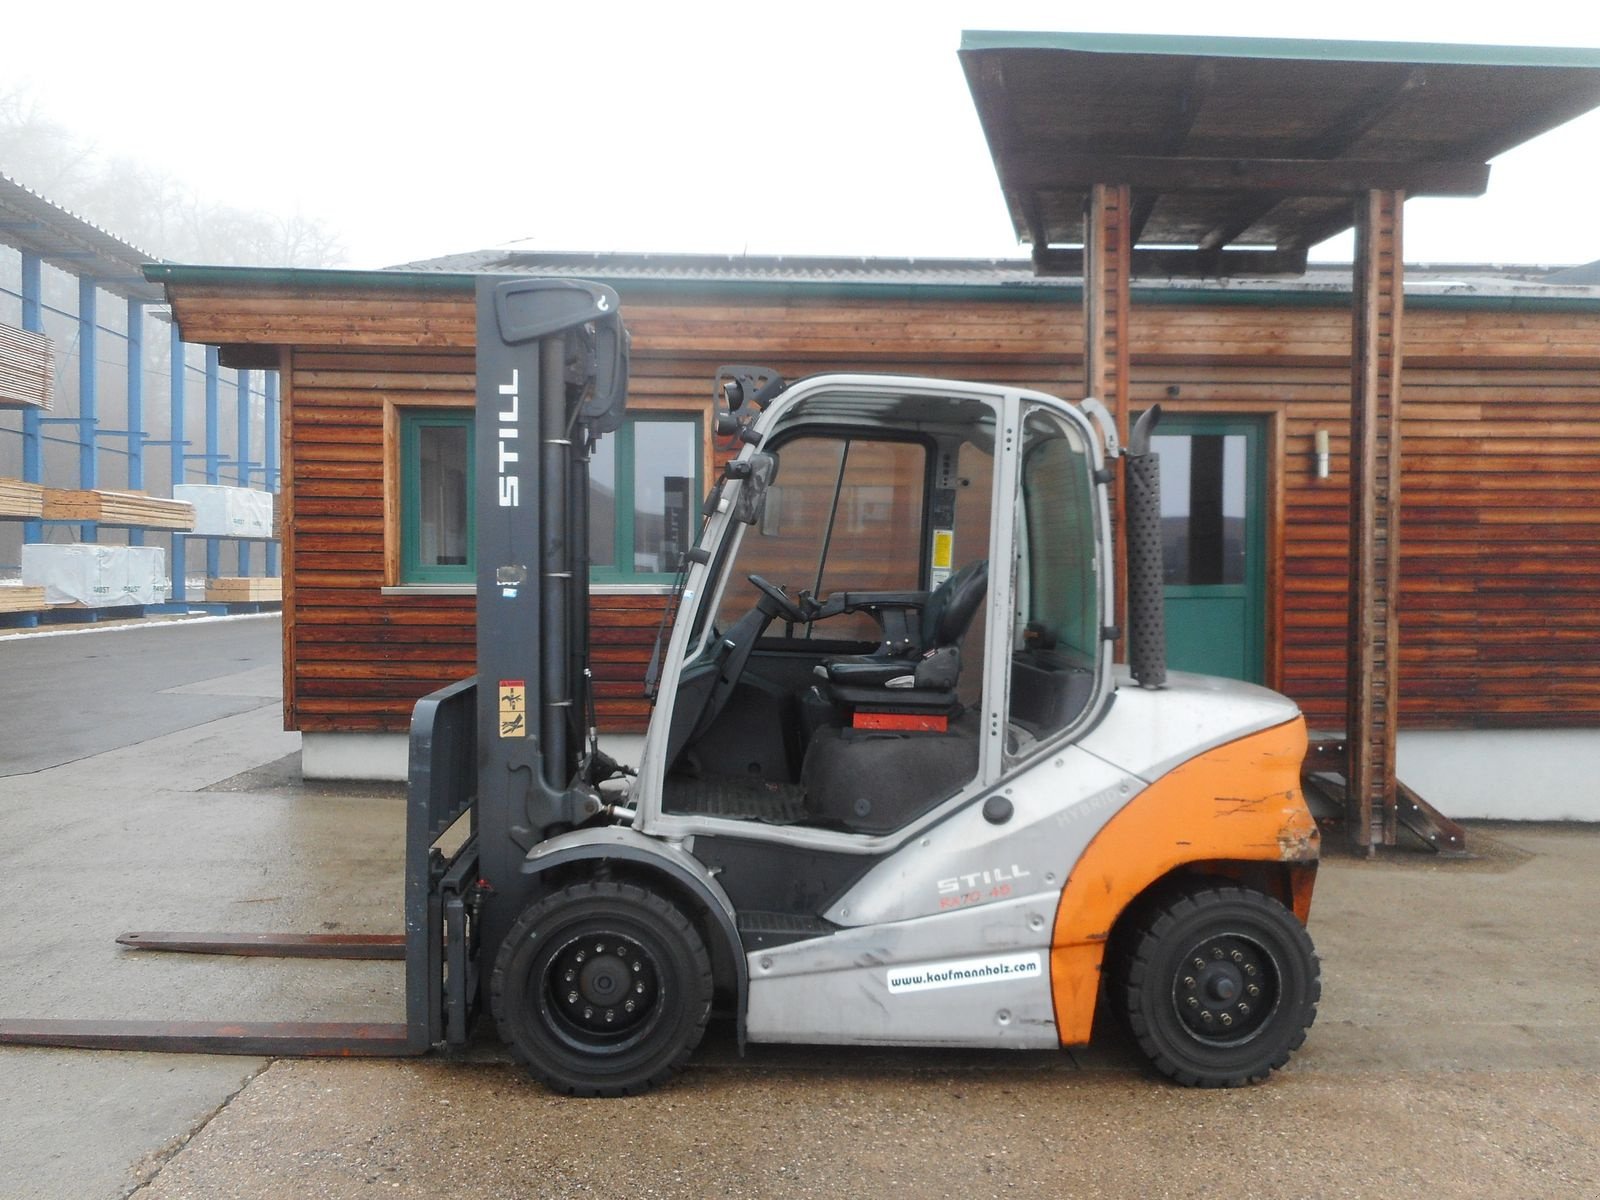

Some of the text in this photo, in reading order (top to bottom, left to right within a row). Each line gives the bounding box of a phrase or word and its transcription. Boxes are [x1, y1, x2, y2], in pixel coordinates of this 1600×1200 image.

[499, 369, 519, 507] STILL
[937, 864, 1030, 895] STILL
[891, 962, 1037, 987] www.kaufmannholz.com
